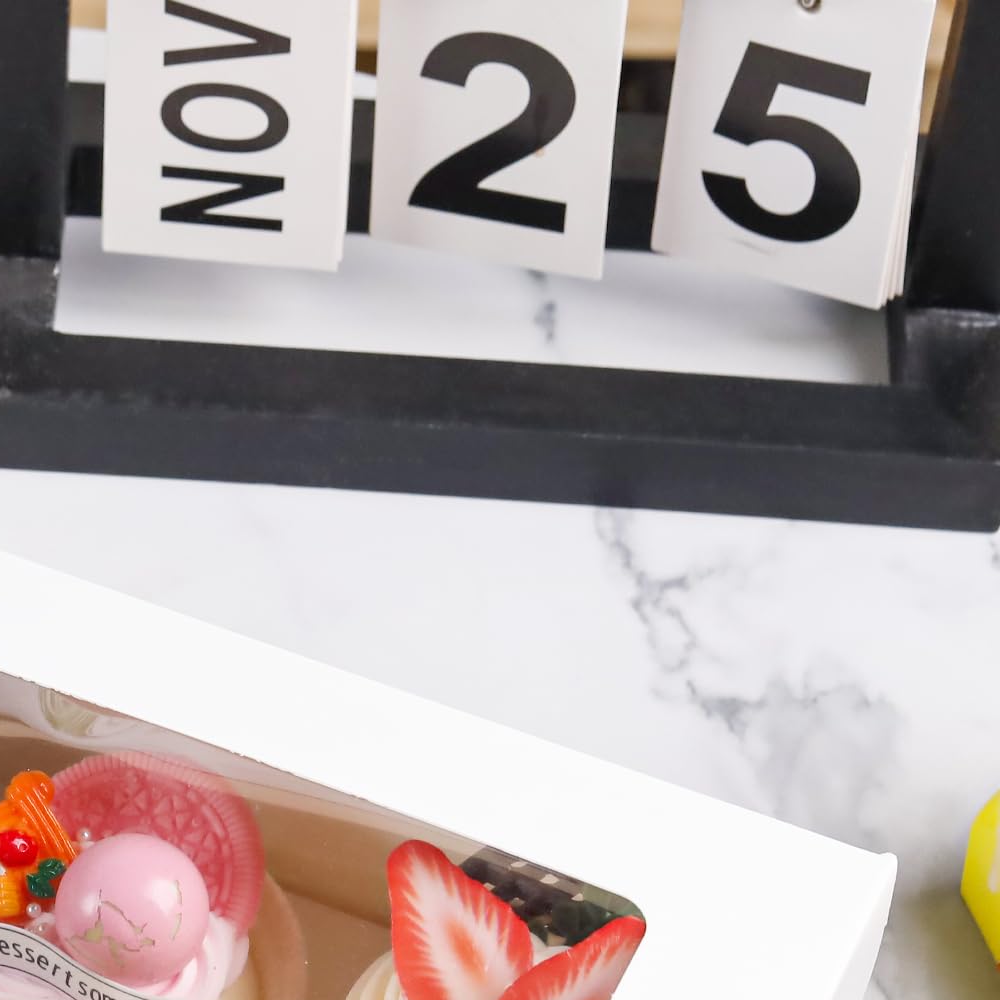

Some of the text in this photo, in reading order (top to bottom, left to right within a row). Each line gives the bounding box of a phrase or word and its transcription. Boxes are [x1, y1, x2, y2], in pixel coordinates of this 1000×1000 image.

[159, 0, 291, 232] NOV
[408, 31, 872, 243] 2 5
